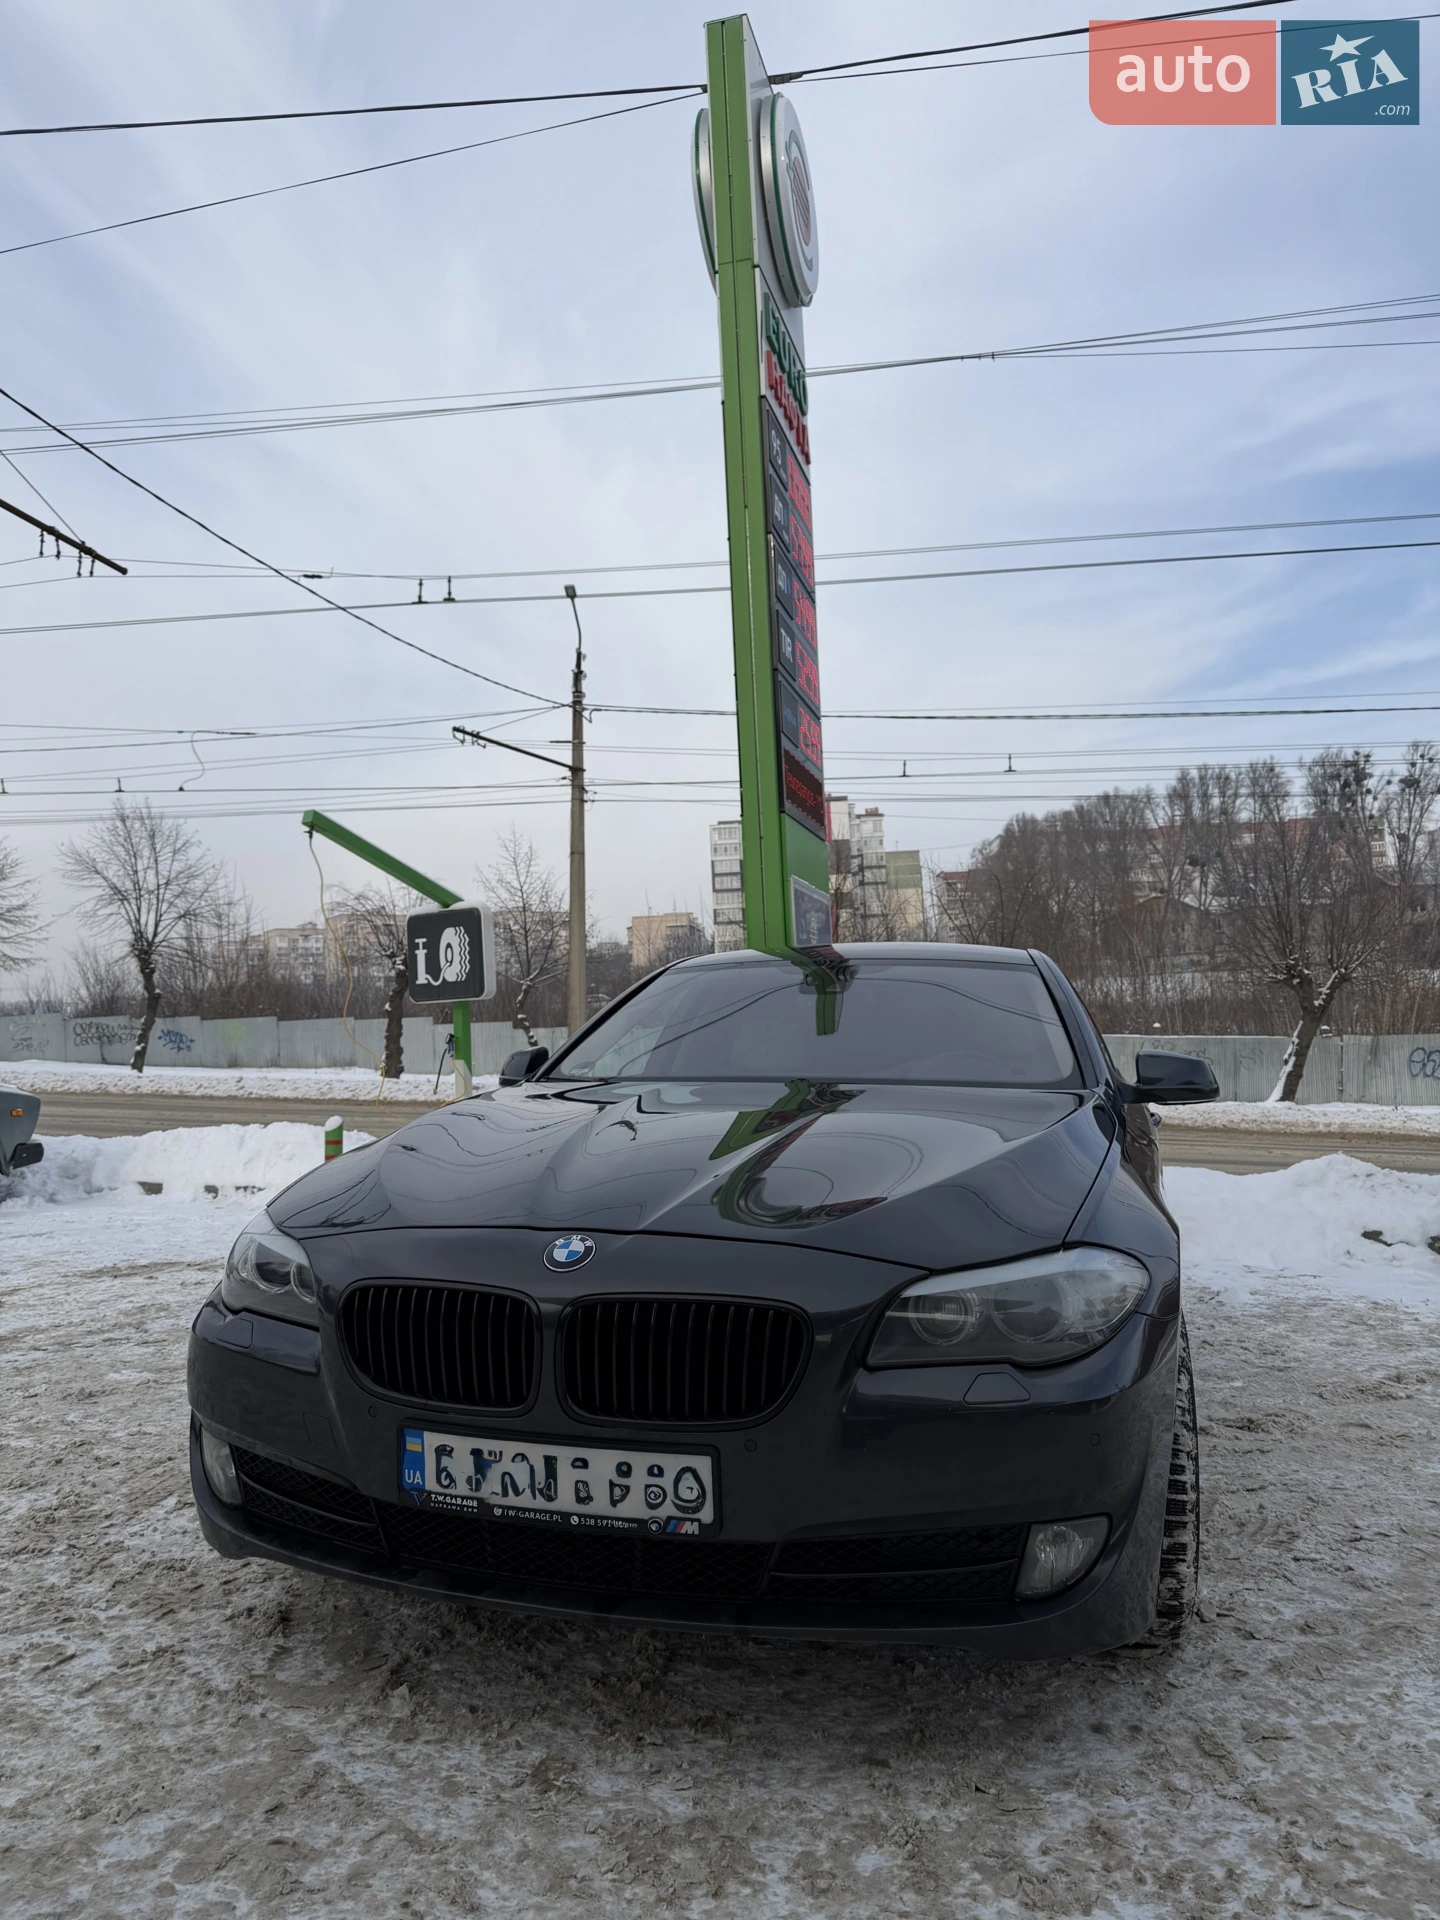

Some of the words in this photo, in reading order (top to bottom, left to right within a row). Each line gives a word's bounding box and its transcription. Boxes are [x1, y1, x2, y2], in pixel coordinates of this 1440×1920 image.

[763, 292, 808, 416] EURO
[405, 1468, 423, 1485] UA
[580, 1517, 595, 1526] 538
